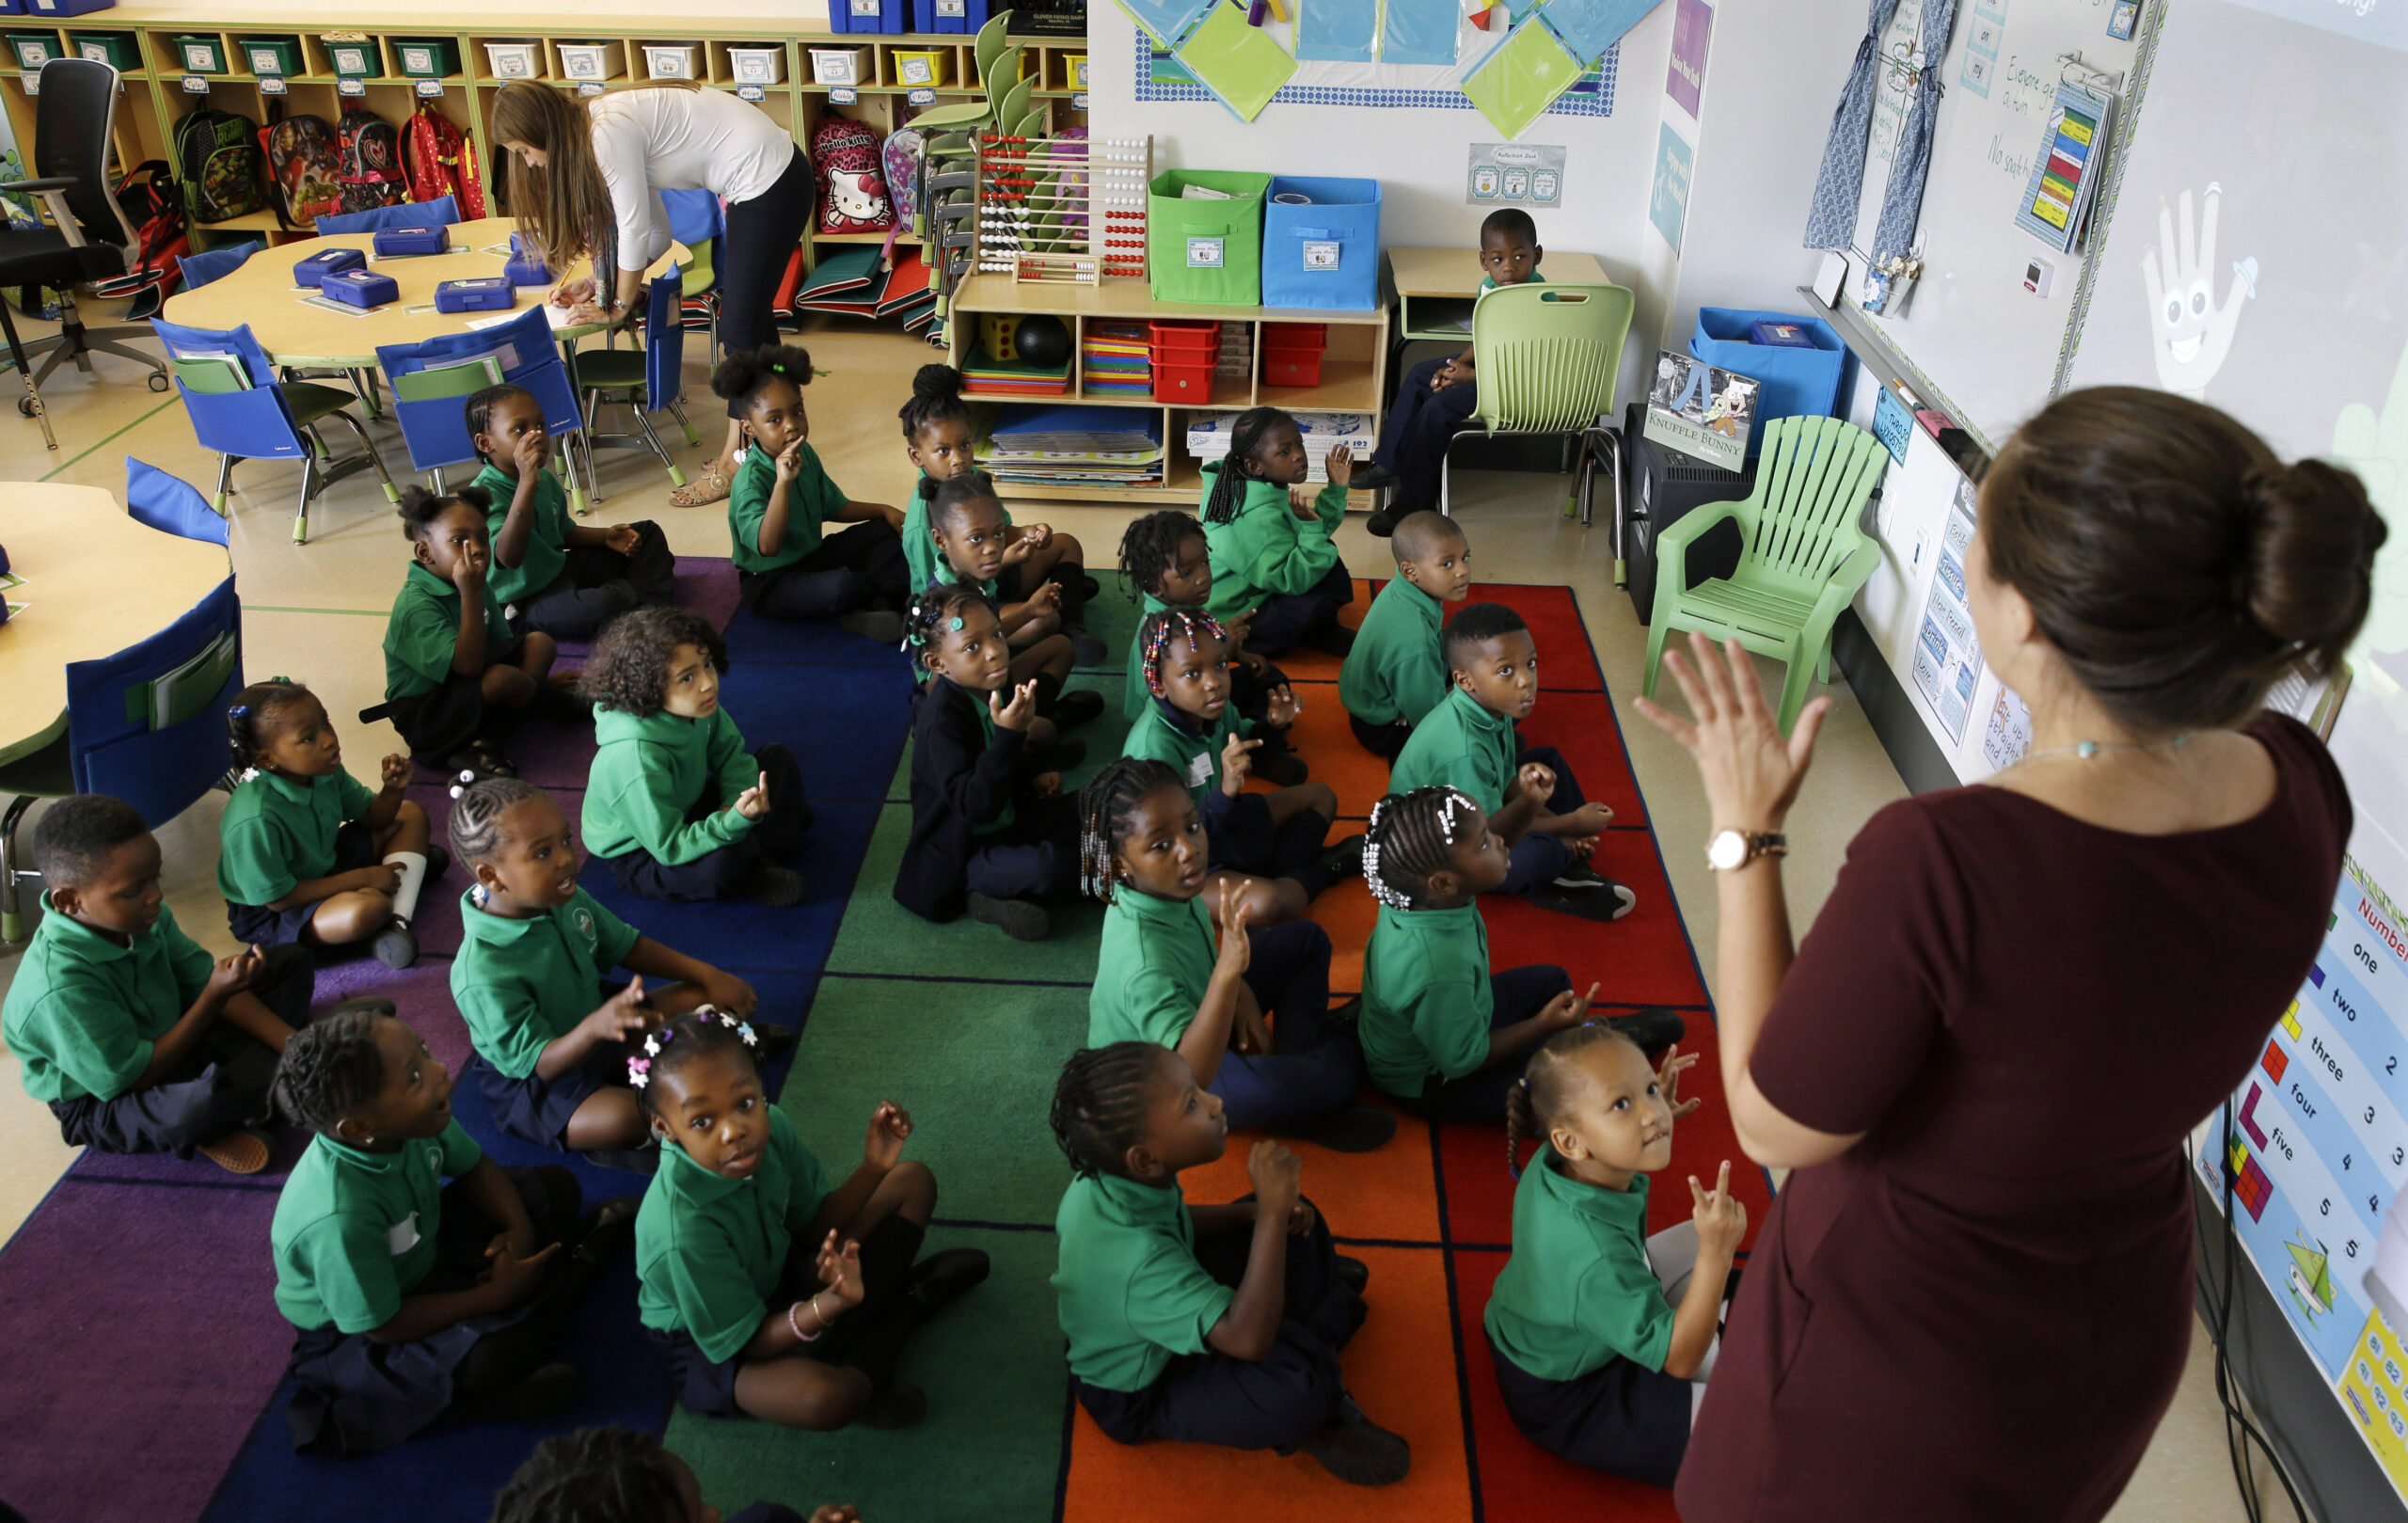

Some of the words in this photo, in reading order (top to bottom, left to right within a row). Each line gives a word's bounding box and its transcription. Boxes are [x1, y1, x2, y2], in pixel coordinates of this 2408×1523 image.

[1981, 31, 1989, 41] on
[1972, 62, 1983, 79] my
[820, 138, 847, 151] Hello
[1988, 132, 2003, 166] No
[1648, 412, 1698, 441] KNUFFLE
[1701, 432, 1741, 455] BUNNY
[1925, 624, 1944, 653] Drink
[1946, 606, 1965, 640] Pencil
[1986, 738, 2002, 760] and
[1988, 719, 2020, 760] straight
[2013, 723, 2022, 741] up
[2353, 943, 2378, 975] one
[2332, 988, 2356, 1023] two
[2385, 1055, 2398, 1076] 2
[2311, 1036, 2344, 1082] three
[2364, 1105, 2375, 1125] 3
[2392, 1146, 2404, 1166] 3
[2289, 1083, 2317, 1119] four
[2342, 1153, 2352, 1171] 4
[2368, 1194, 2380, 1214] 4
[2271, 1126, 2293, 1161] five
[2320, 1198, 2332, 1216] 5
[2345, 1238, 2359, 1259] 5
[2384, 1359, 2400, 1384] 82
[2373, 1385, 2386, 1409] 92
[2389, 1410, 2404, 1436] 93
